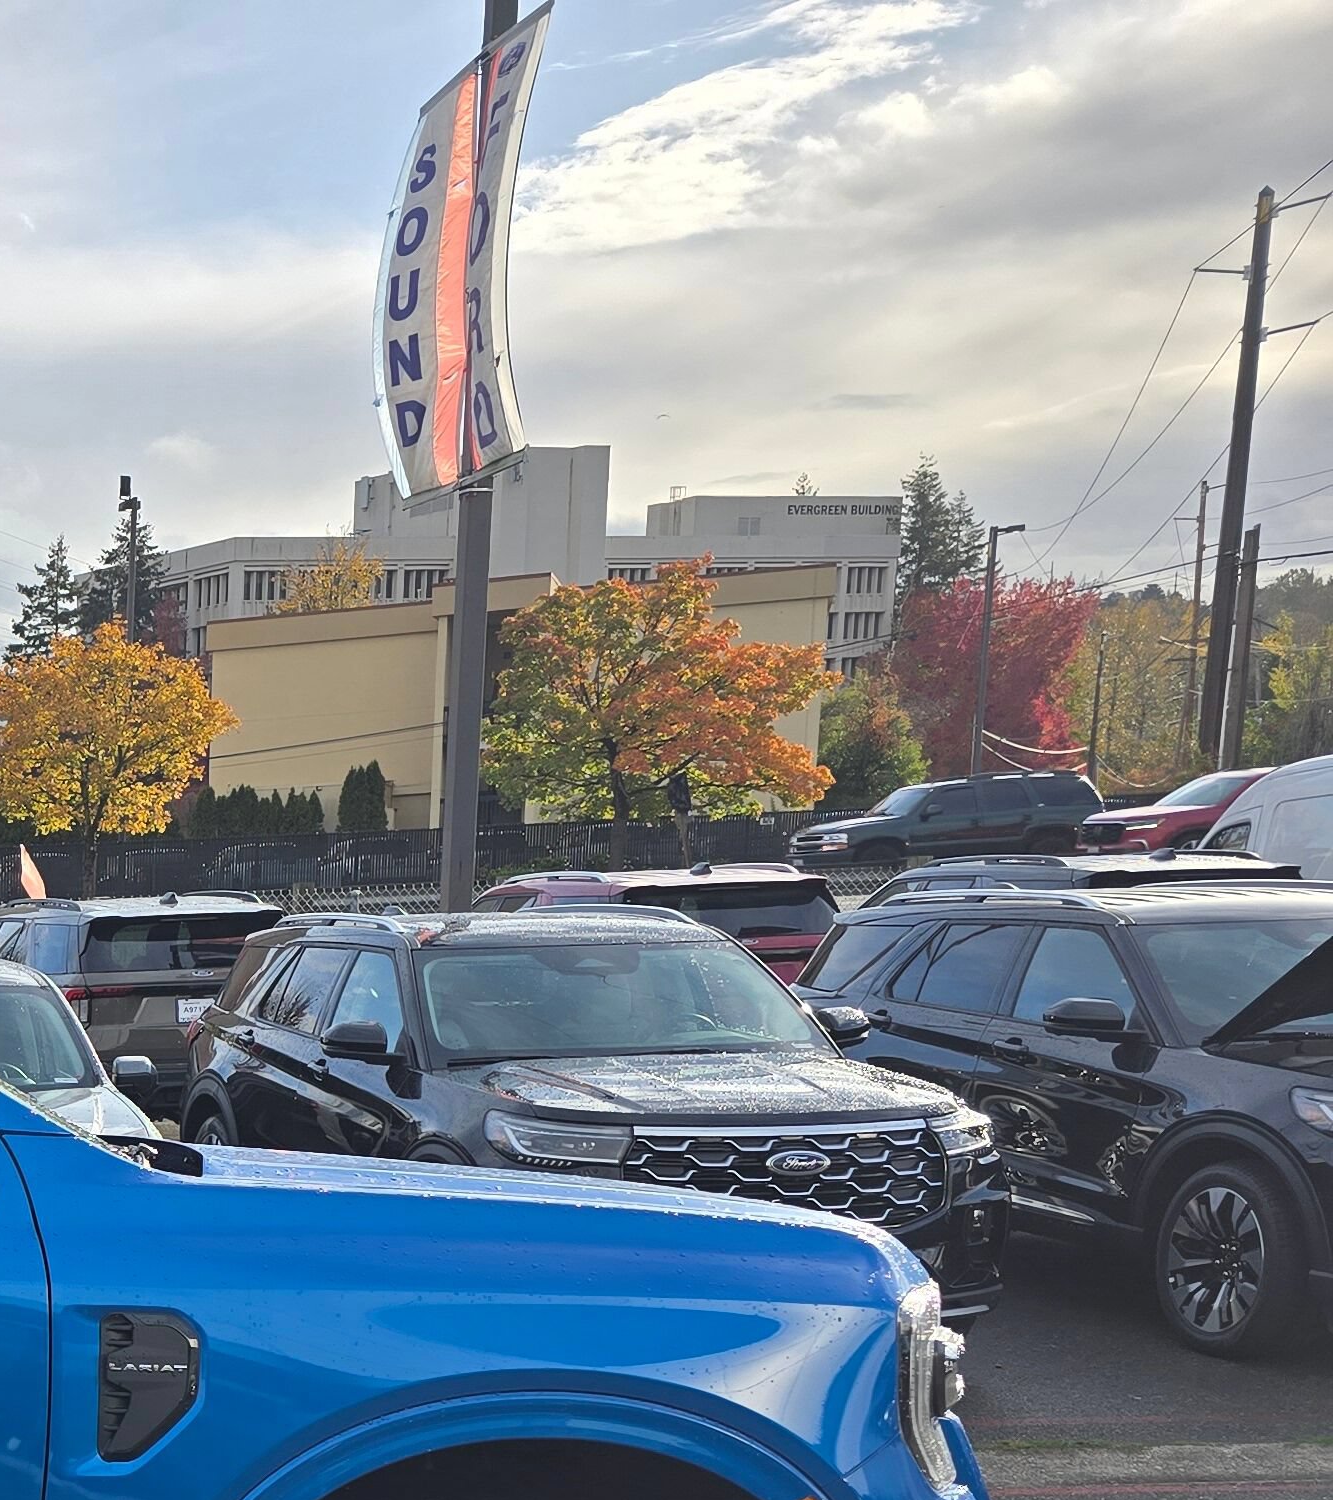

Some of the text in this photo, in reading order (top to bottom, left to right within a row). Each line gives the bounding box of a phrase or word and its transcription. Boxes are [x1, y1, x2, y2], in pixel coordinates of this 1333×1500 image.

[387, 143, 437, 448] SOUND
[787, 505, 901, 515] EVERGREEN BUILDING
[108, 1362, 188, 1373] LARIAT
